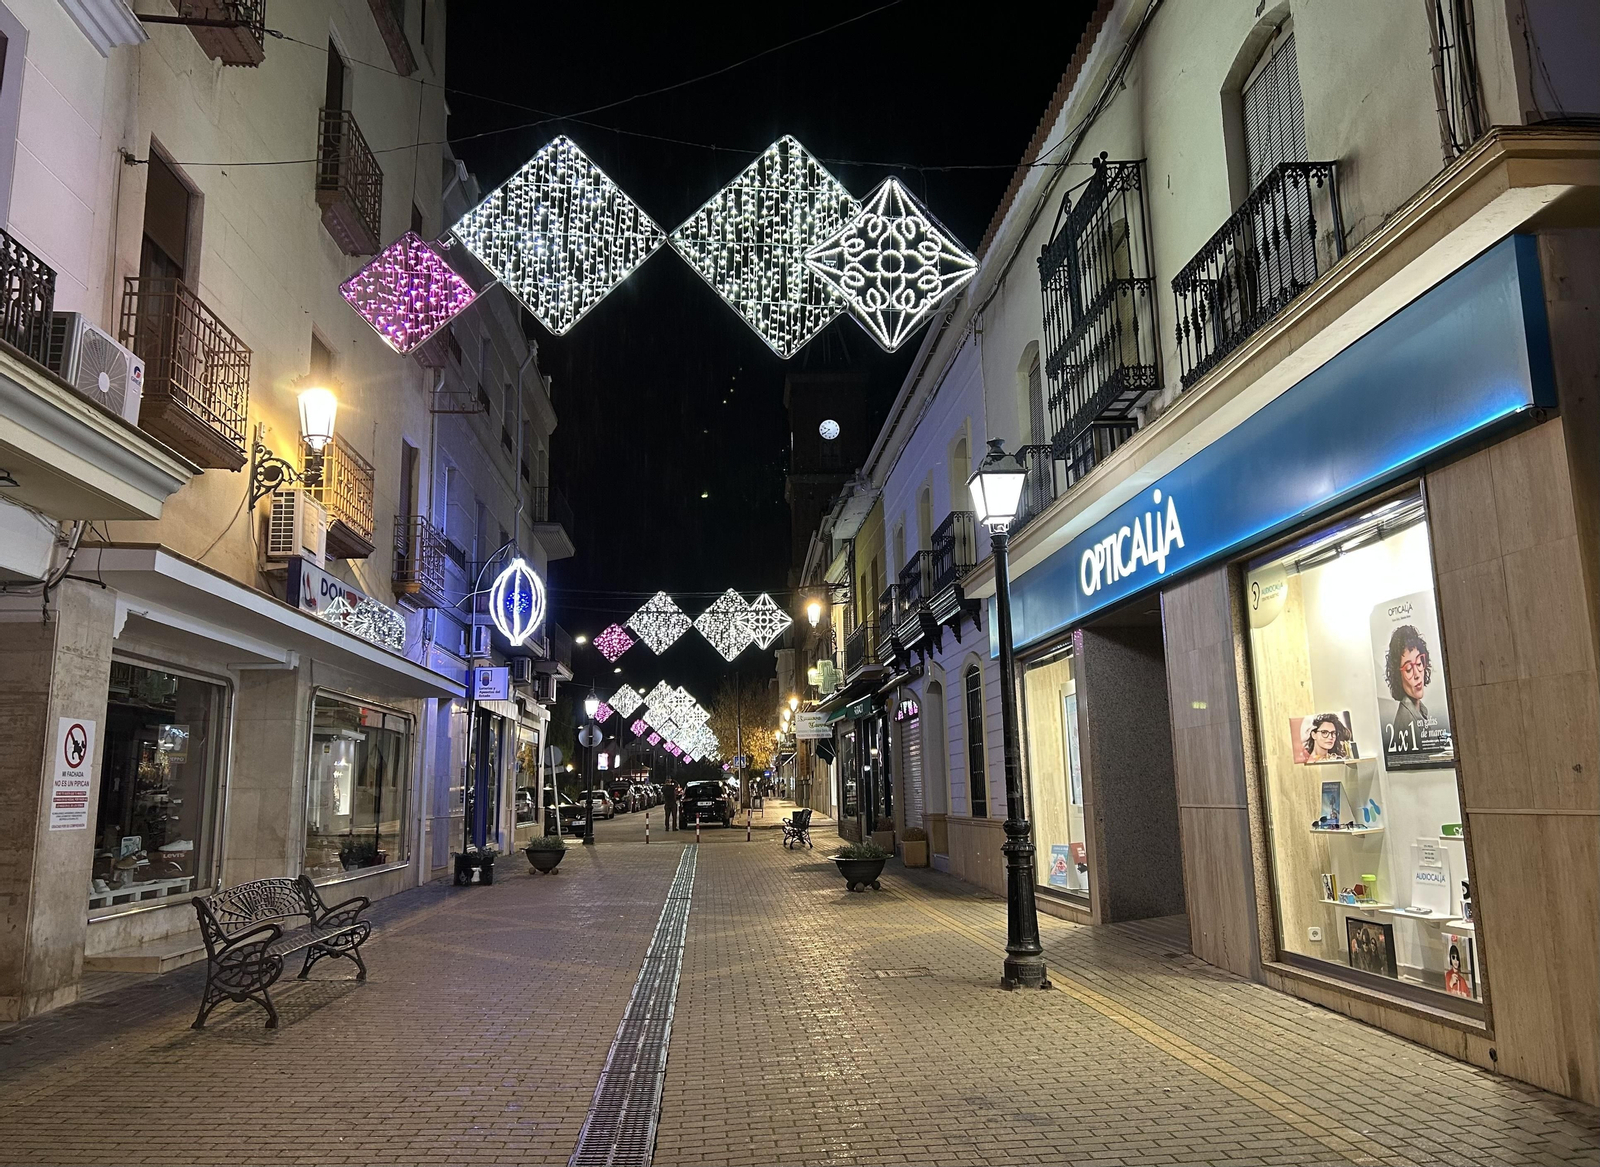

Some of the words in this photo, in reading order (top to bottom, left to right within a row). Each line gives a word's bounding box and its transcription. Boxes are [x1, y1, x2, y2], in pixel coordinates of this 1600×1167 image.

[1416, 719, 1424, 727] en
[1424, 715, 1438, 729] gafas
[1420, 728, 1427, 738] de
